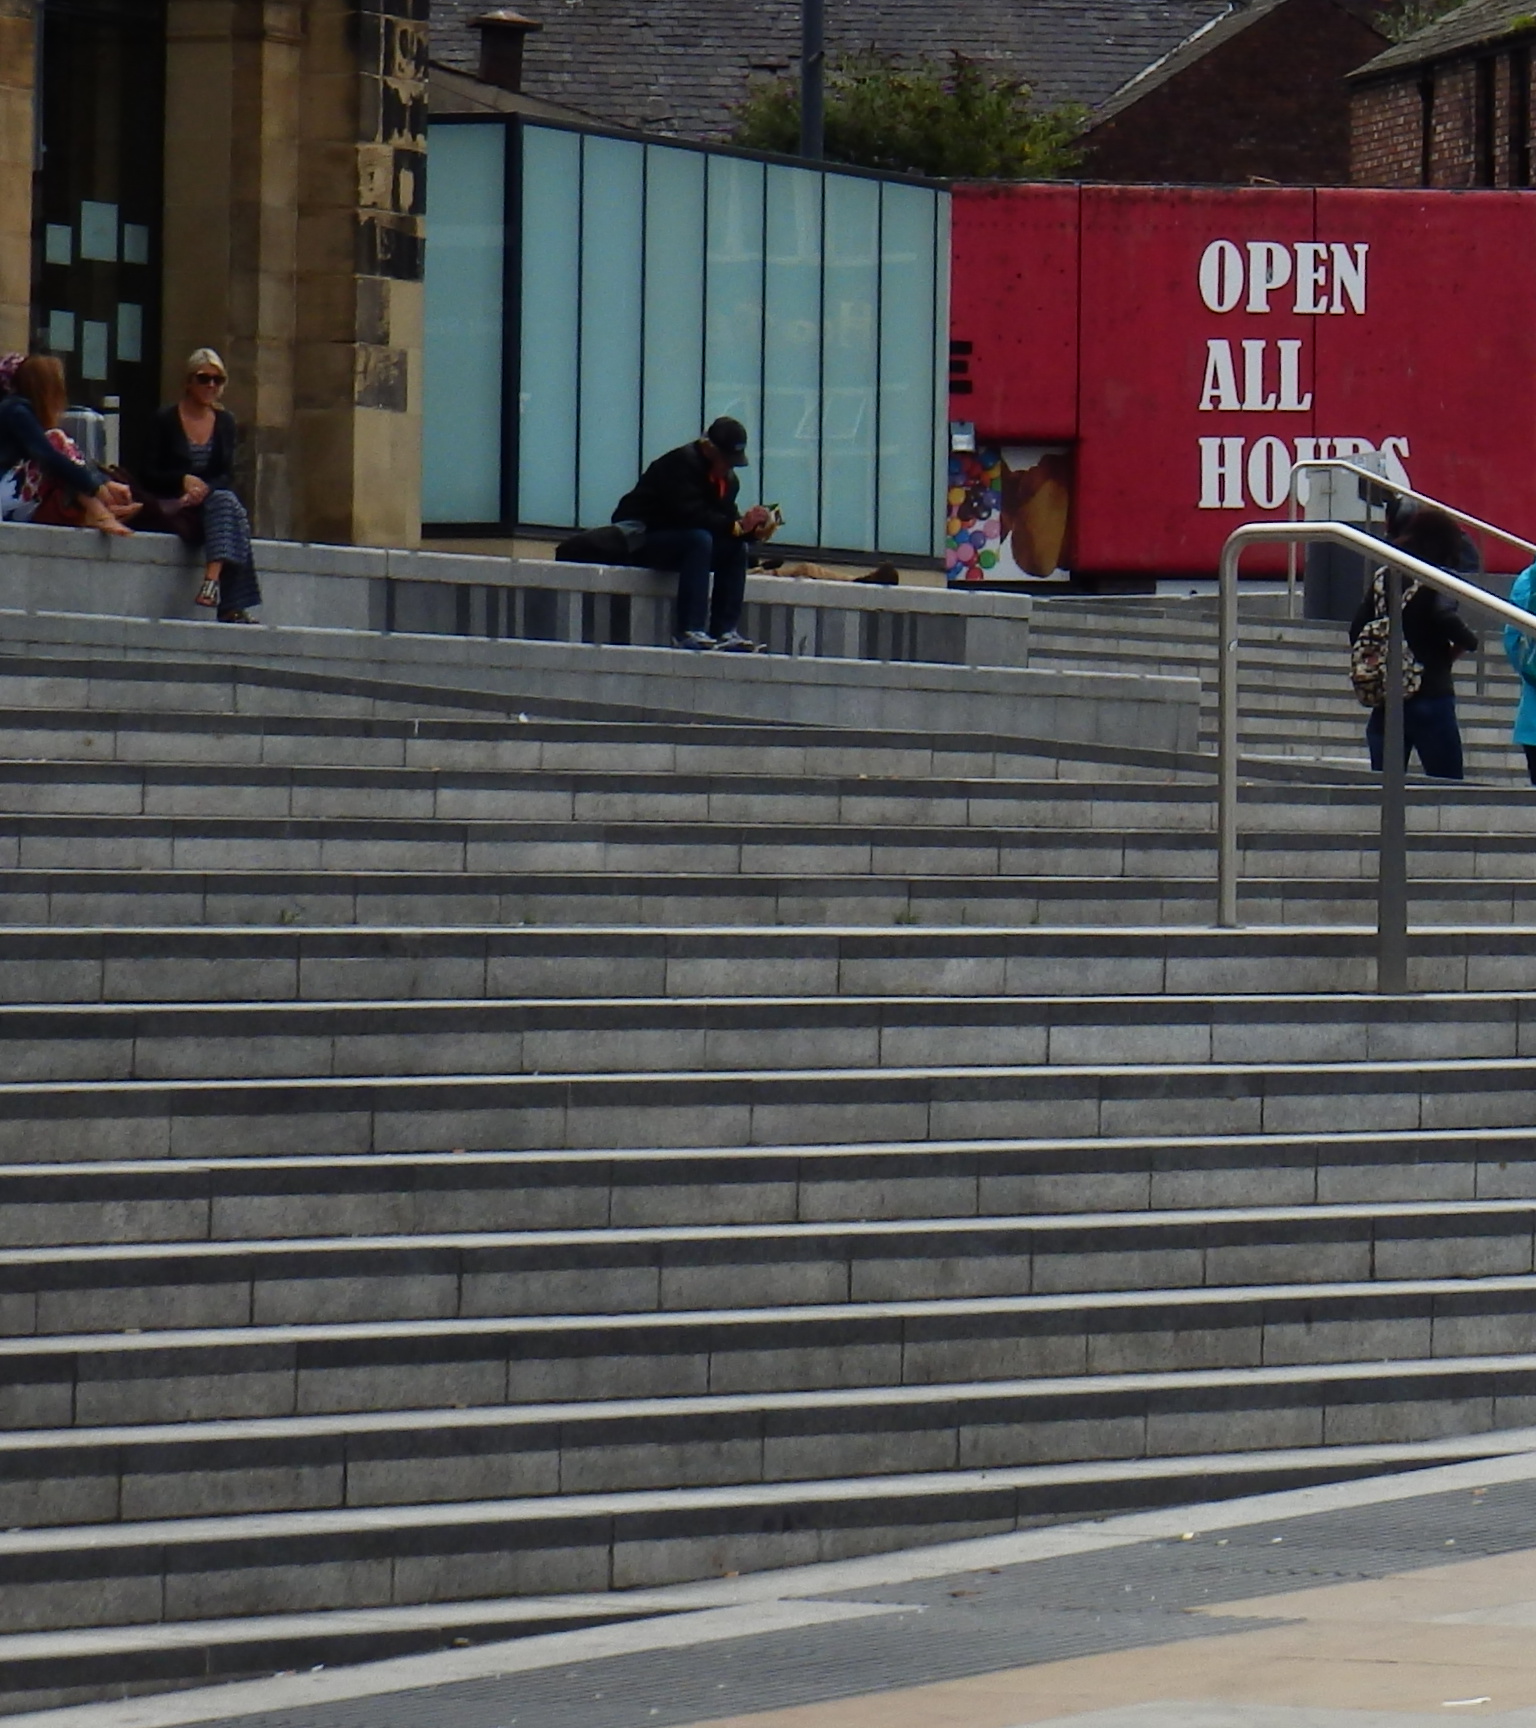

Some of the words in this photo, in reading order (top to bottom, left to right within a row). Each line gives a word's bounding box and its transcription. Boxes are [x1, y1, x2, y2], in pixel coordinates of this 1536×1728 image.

[1198, 239, 1370, 316] OPEN
[1198, 338, 1312, 412] ALL
[1198, 435, 1412, 510] HOUS
